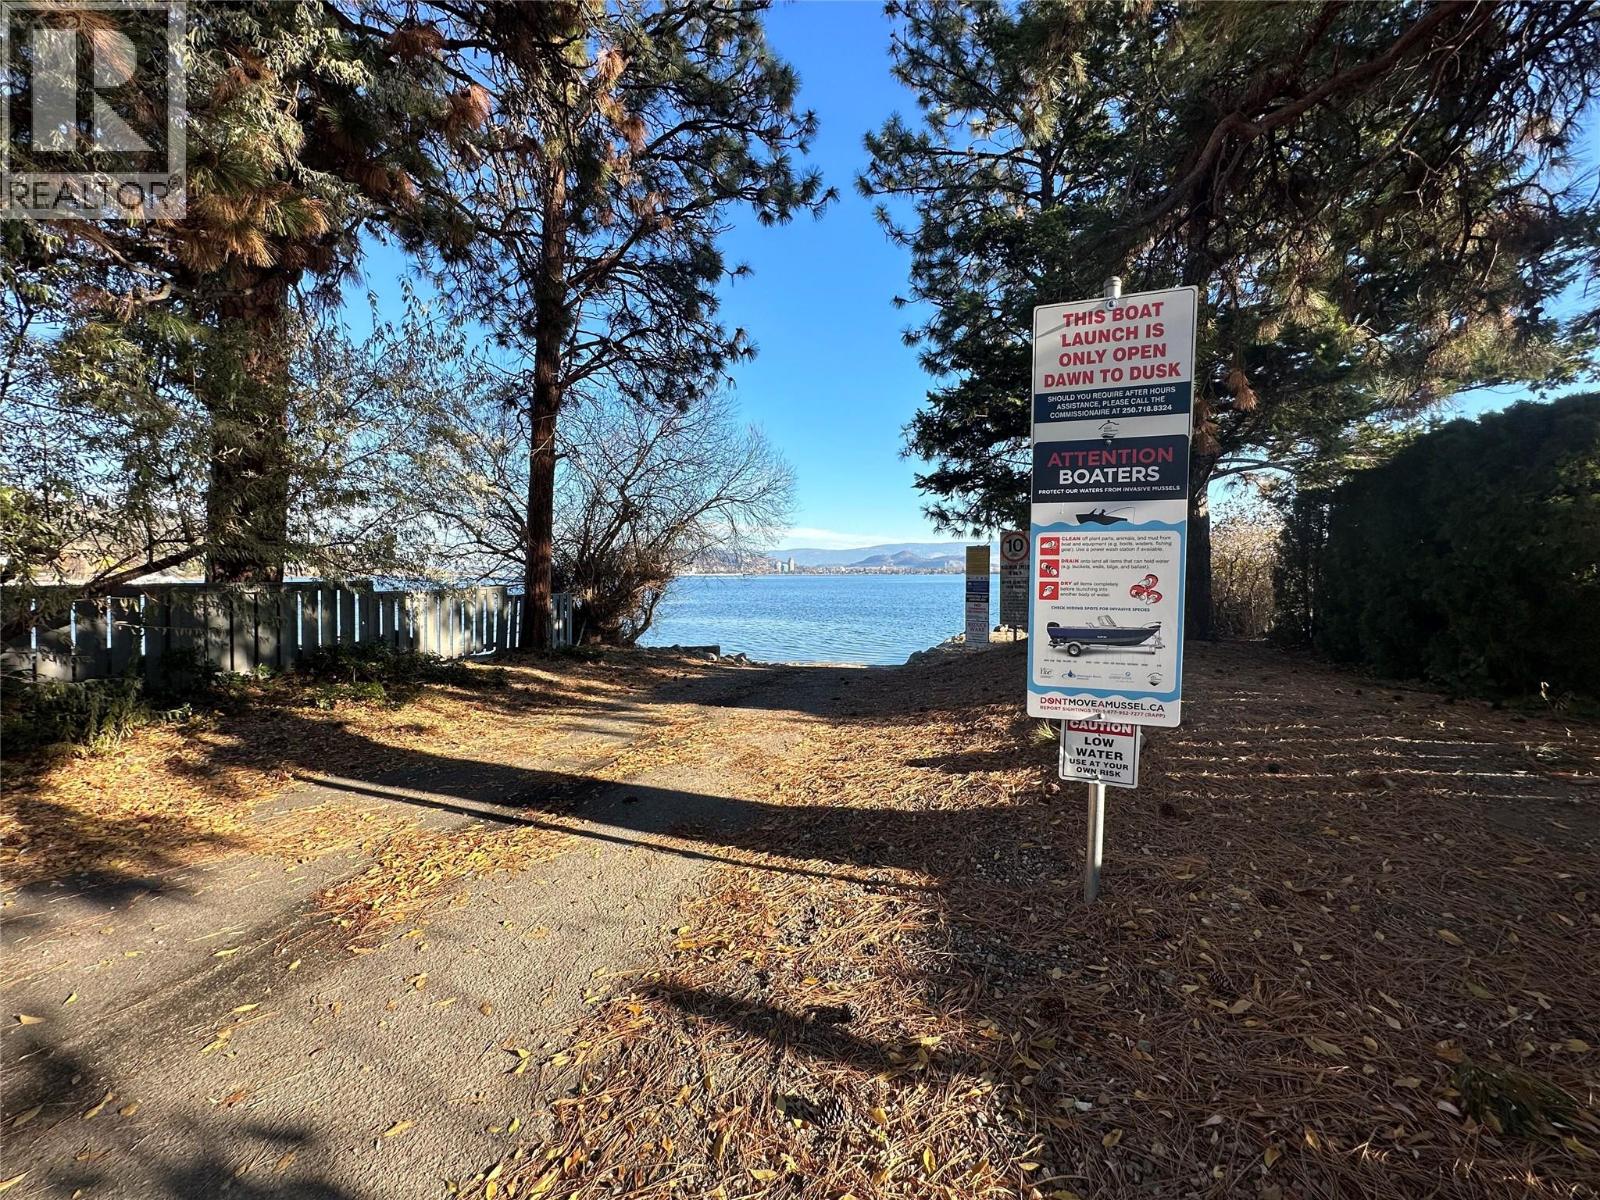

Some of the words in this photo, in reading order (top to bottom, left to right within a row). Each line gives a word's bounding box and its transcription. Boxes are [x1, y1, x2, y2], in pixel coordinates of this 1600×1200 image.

[1063, 310, 1105, 327] THIS
[1112, 302, 1164, 322] BOAT
[1061, 326, 1138, 347] LAUNCH
[1146, 323, 1164, 338] IS
[1059, 349, 1107, 367] ONLY
[1113, 343, 1166, 361] OPEN
[1044, 371, 1094, 388] DAWN
[1100, 368, 1123, 382] TO
[1130, 362, 1181, 380] DUSK
[1048, 394, 1075, 402] SHOULD
[1092, 391, 1124, 399] REQUIRE
[1150, 386, 1176, 394] HOURS
[1050, 408, 1110, 418] COMMISSIONAIRE
[1122, 404, 1172, 414] 250.718.8324
[1056, 401, 1100, 410] ASSISTANCE,
[1048, 446, 1173, 467] ATTENTION
[1059, 466, 1159, 484] BOATERS
[1006, 538, 1024, 553] 10
[1040, 696, 1165, 712] DONTMOVEAMUSSEL.CA
[1069, 720, 1132, 734] CAUTION
[1084, 737, 1114, 748] LOW
[1076, 748, 1123, 761] WATER
[1076, 766, 1096, 774] OWN
[1100, 769, 1121, 778] RISK
[1103, 762, 1128, 770] YOUR
